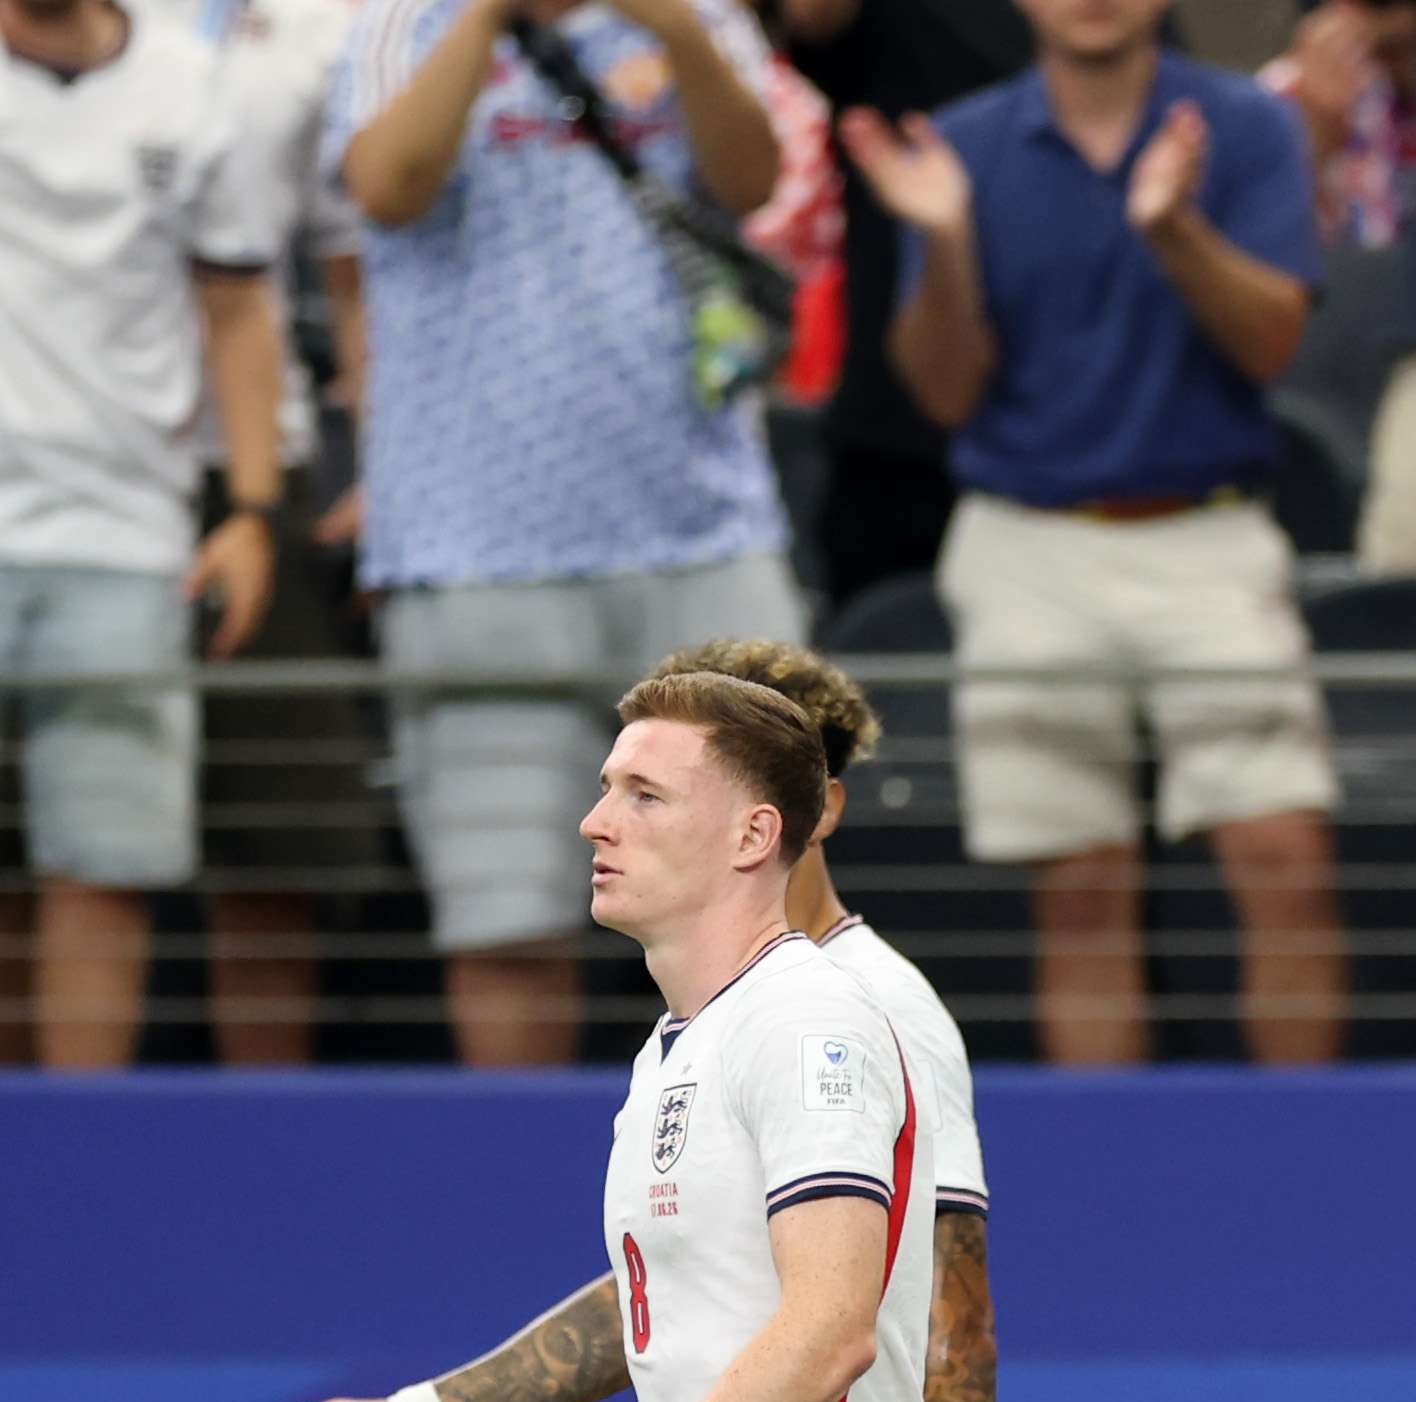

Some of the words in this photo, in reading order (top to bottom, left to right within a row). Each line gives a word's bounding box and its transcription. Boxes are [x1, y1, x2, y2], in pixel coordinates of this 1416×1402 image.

[820, 1082, 853, 1097] PEACE
[649, 1182, 679, 1199] CROATIA
[623, 1232, 651, 1354] 8
